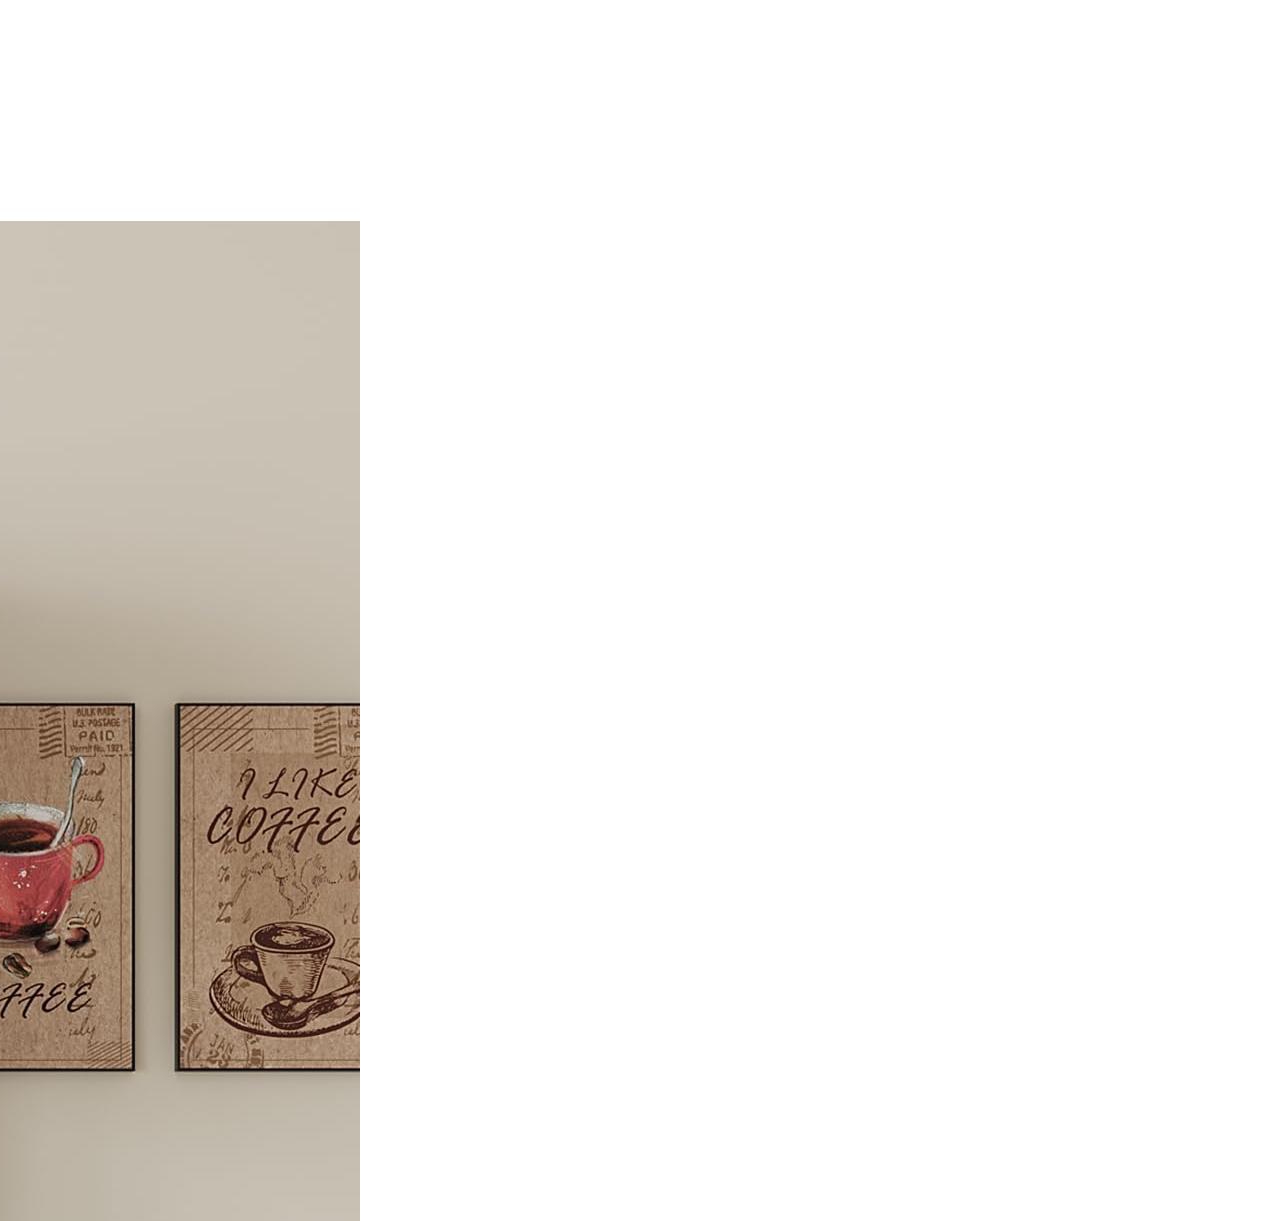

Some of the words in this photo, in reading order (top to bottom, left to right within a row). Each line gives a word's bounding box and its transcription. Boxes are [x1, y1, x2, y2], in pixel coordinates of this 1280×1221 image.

[78, 730, 115, 742] PAID
[239, 767, 256, 800] I
[262, 767, 359, 800] LIKE
